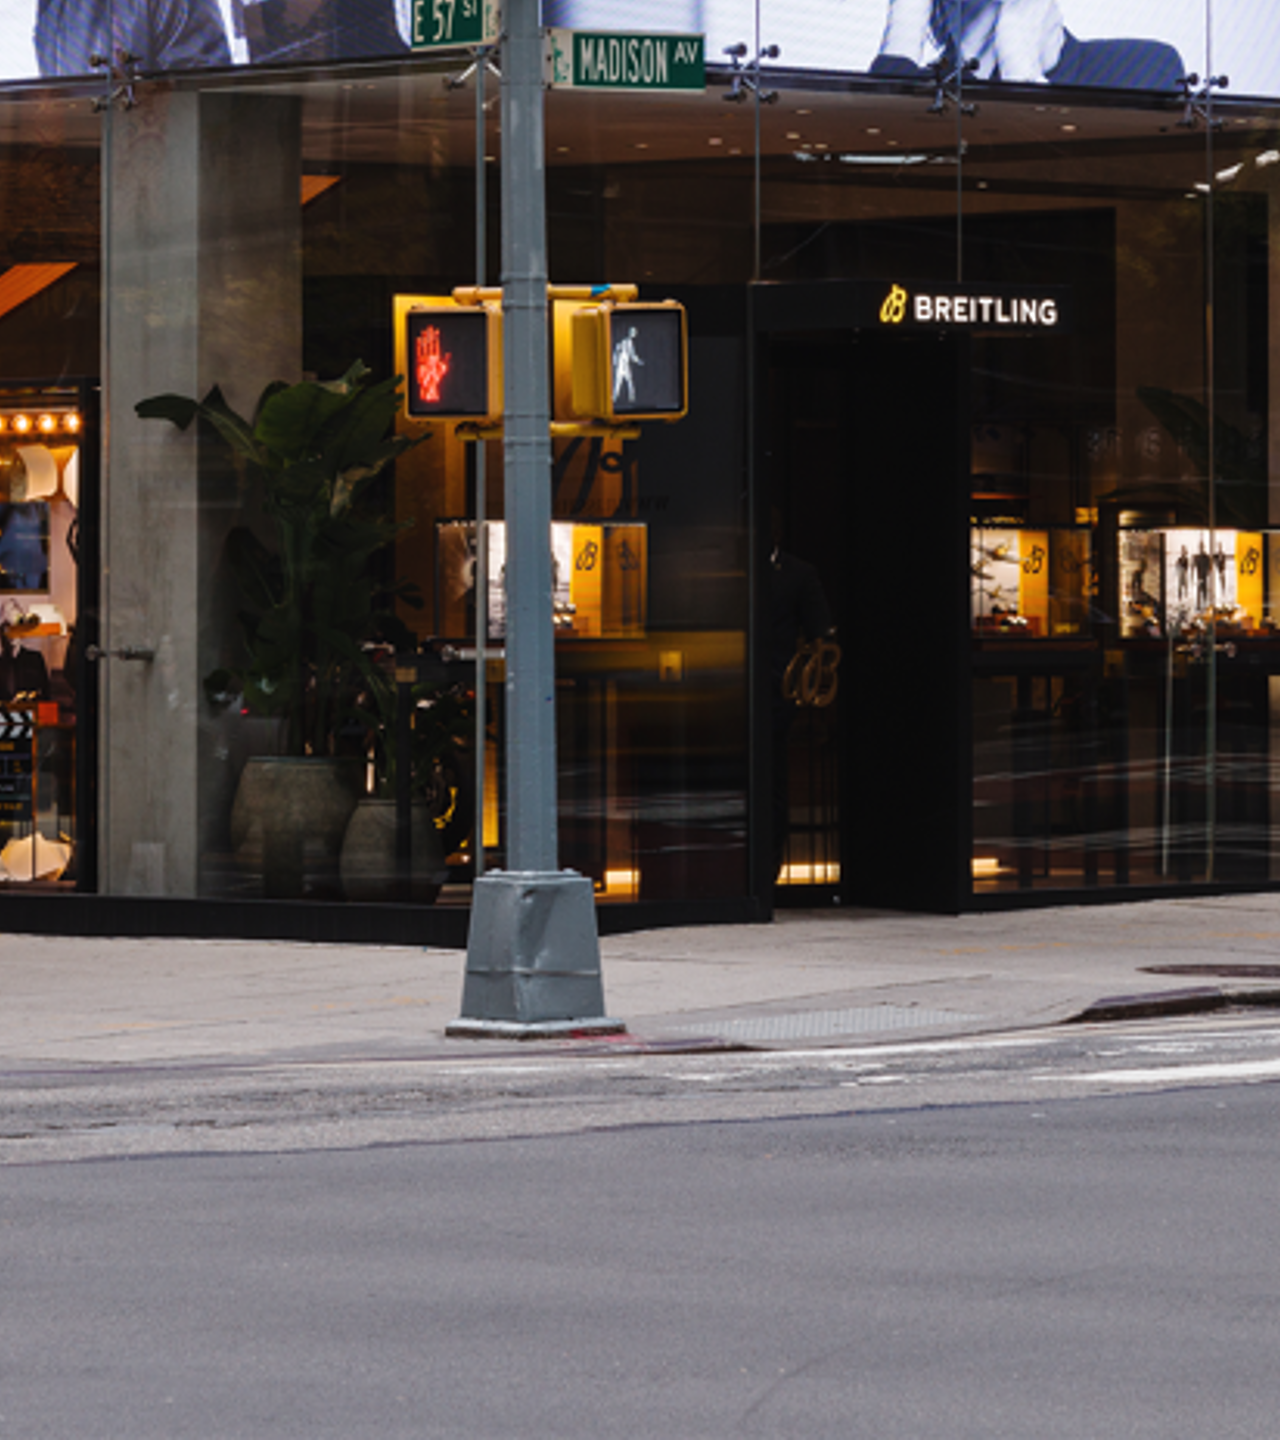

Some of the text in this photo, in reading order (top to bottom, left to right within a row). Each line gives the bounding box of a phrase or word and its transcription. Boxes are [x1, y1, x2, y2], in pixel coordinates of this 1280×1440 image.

[414, 0, 424, 42] E
[581, 38, 668, 83] MADISON
[674, 41, 699, 64] AV
[914, 295, 1058, 325] BREITLING
